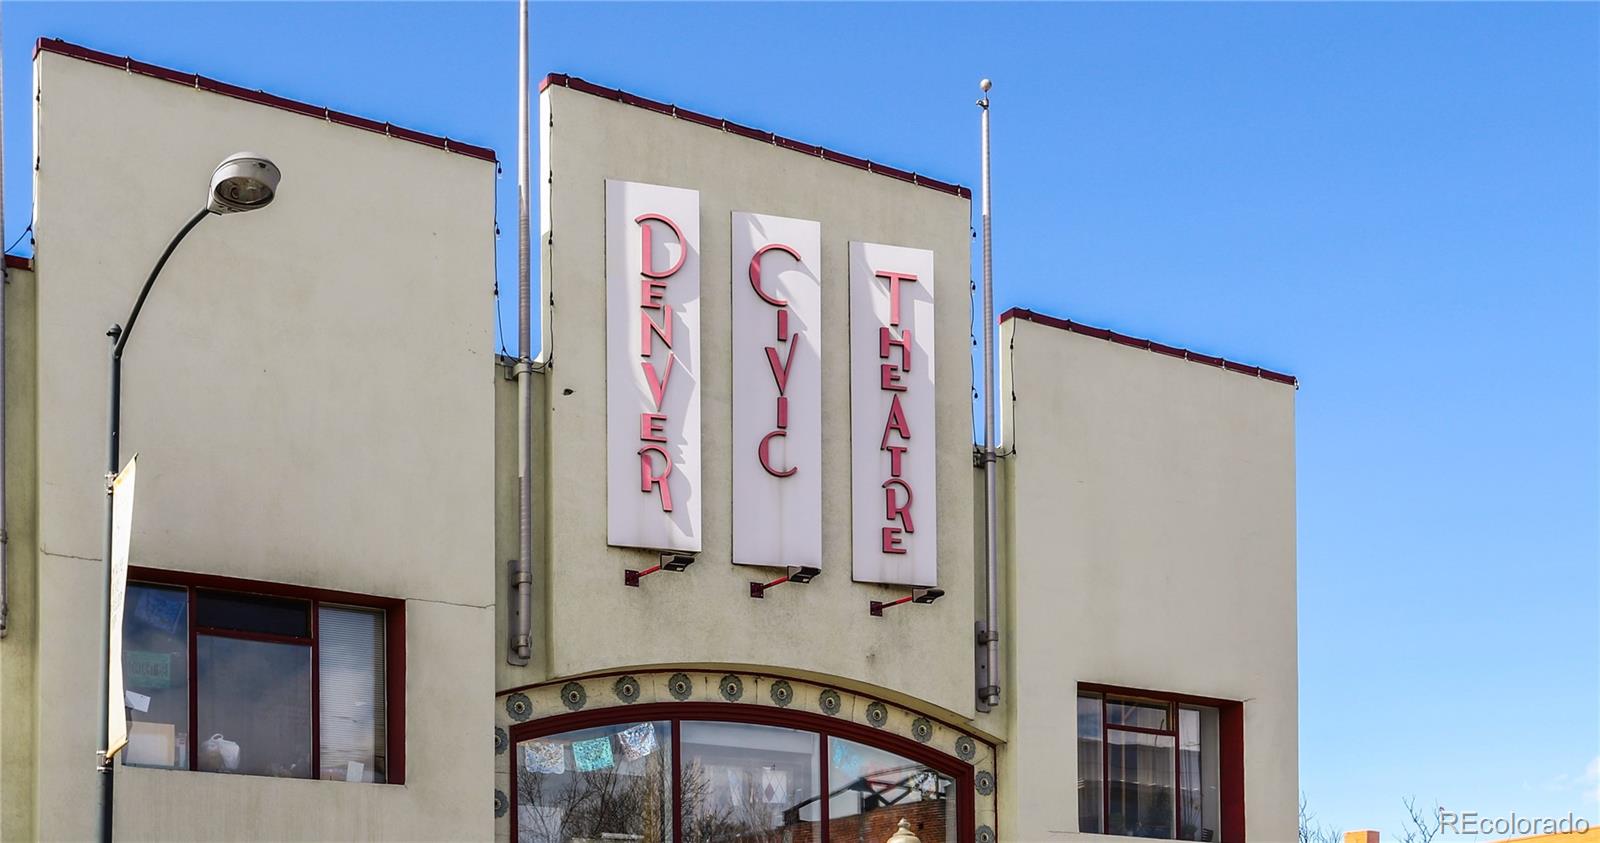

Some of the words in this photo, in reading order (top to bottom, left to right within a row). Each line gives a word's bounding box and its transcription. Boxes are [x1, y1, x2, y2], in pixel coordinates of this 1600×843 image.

[635, 213, 687, 512] DENVER
[749, 243, 801, 478] CIVIC
[874, 270, 917, 554] THEATRE
